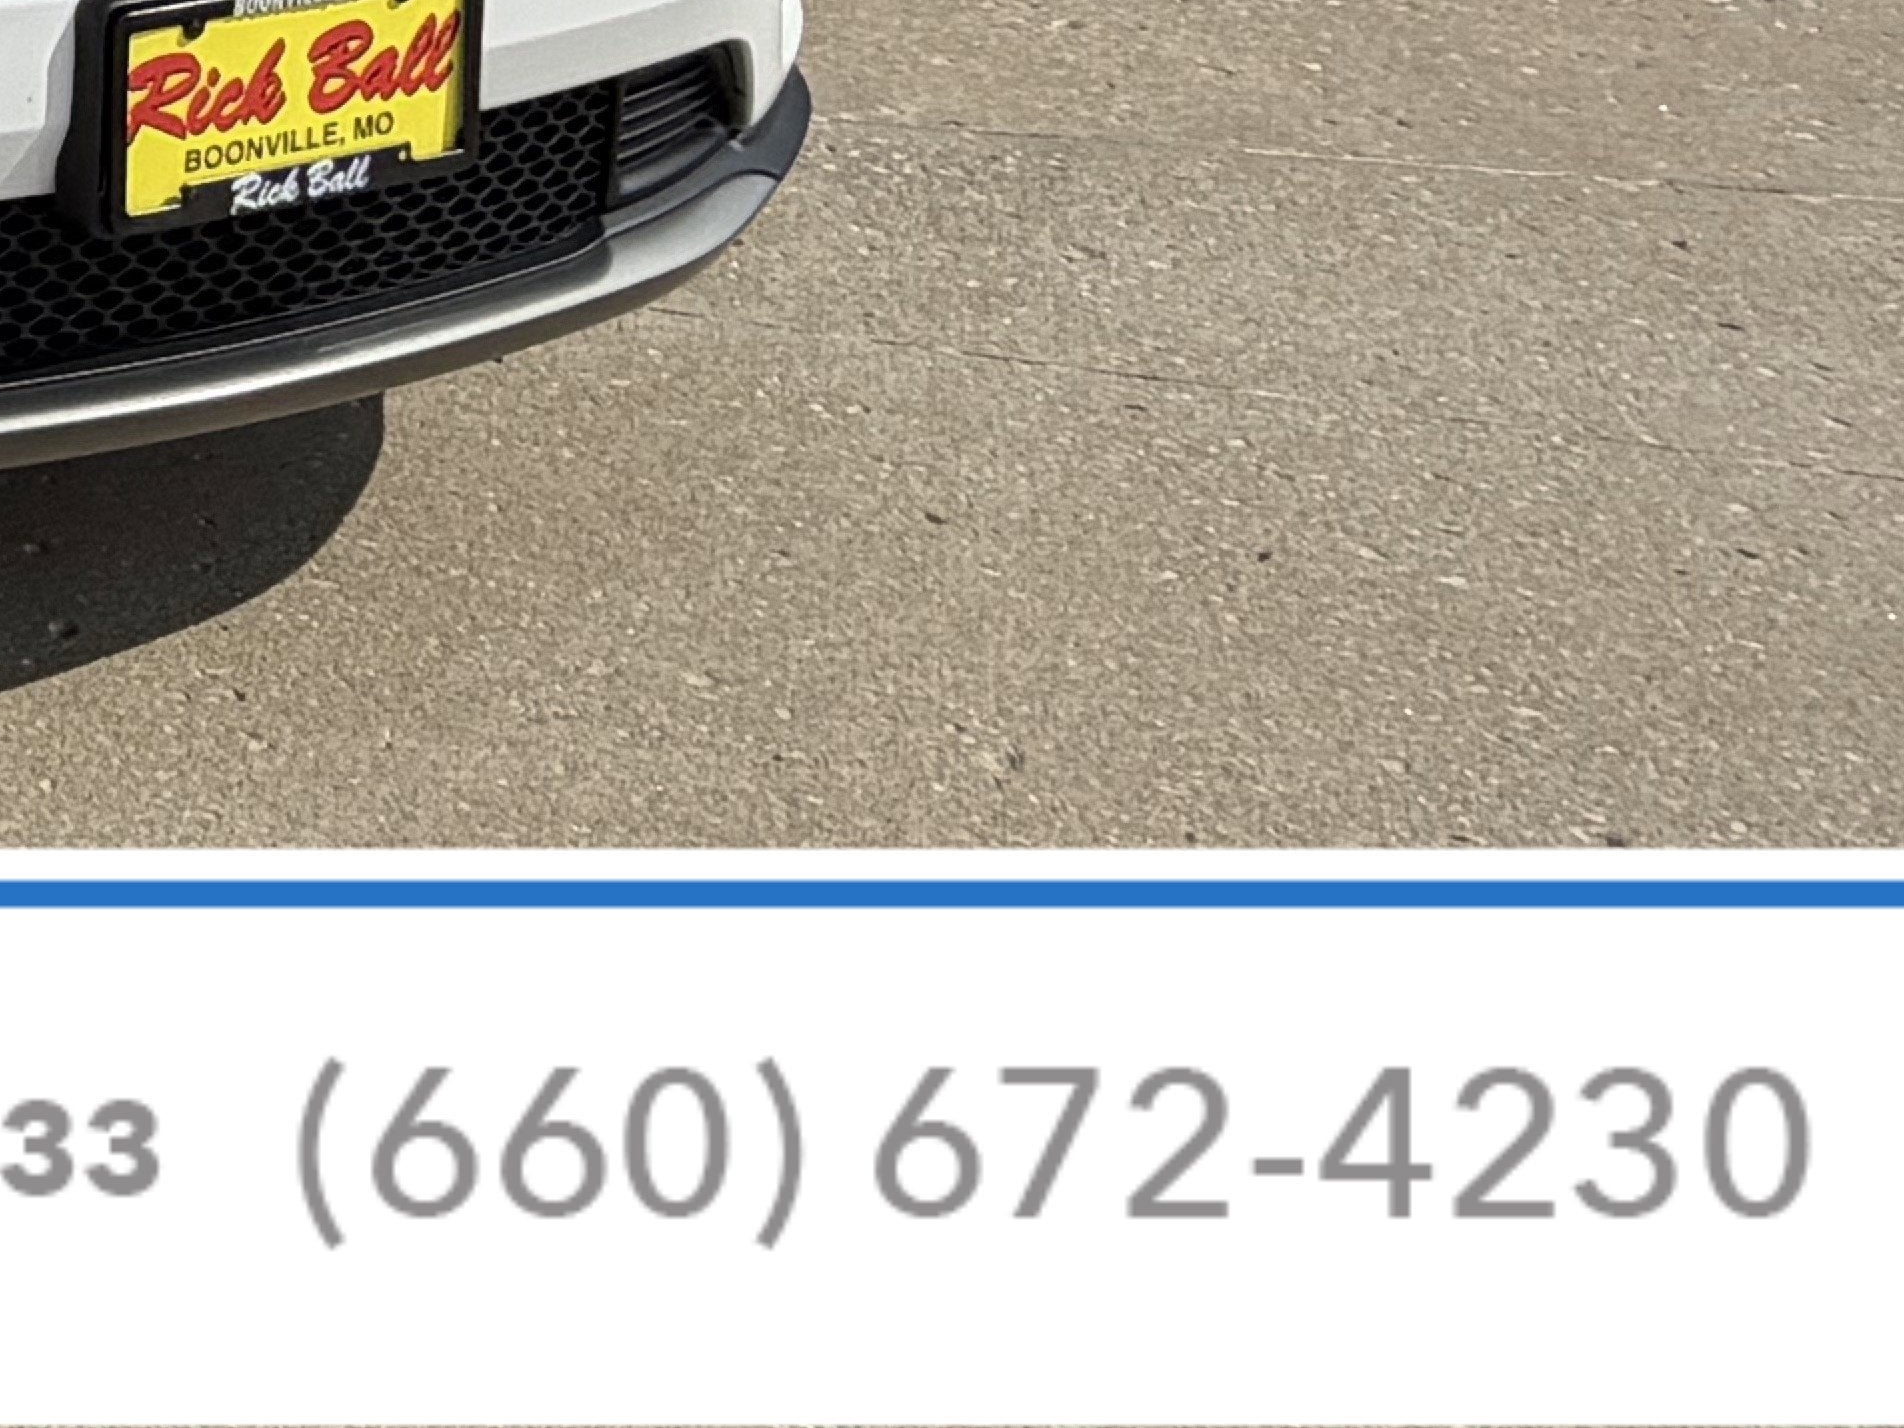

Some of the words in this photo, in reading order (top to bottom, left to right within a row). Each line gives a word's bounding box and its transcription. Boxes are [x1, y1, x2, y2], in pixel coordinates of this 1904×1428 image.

[127, 37, 287, 142] Rick
[308, 8, 462, 113] Ball
[184, 120, 346, 173] BOONVILLE,
[353, 110, 394, 140] MO
[230, 165, 300, 215] Rick
[306, 156, 371, 198] Ball
